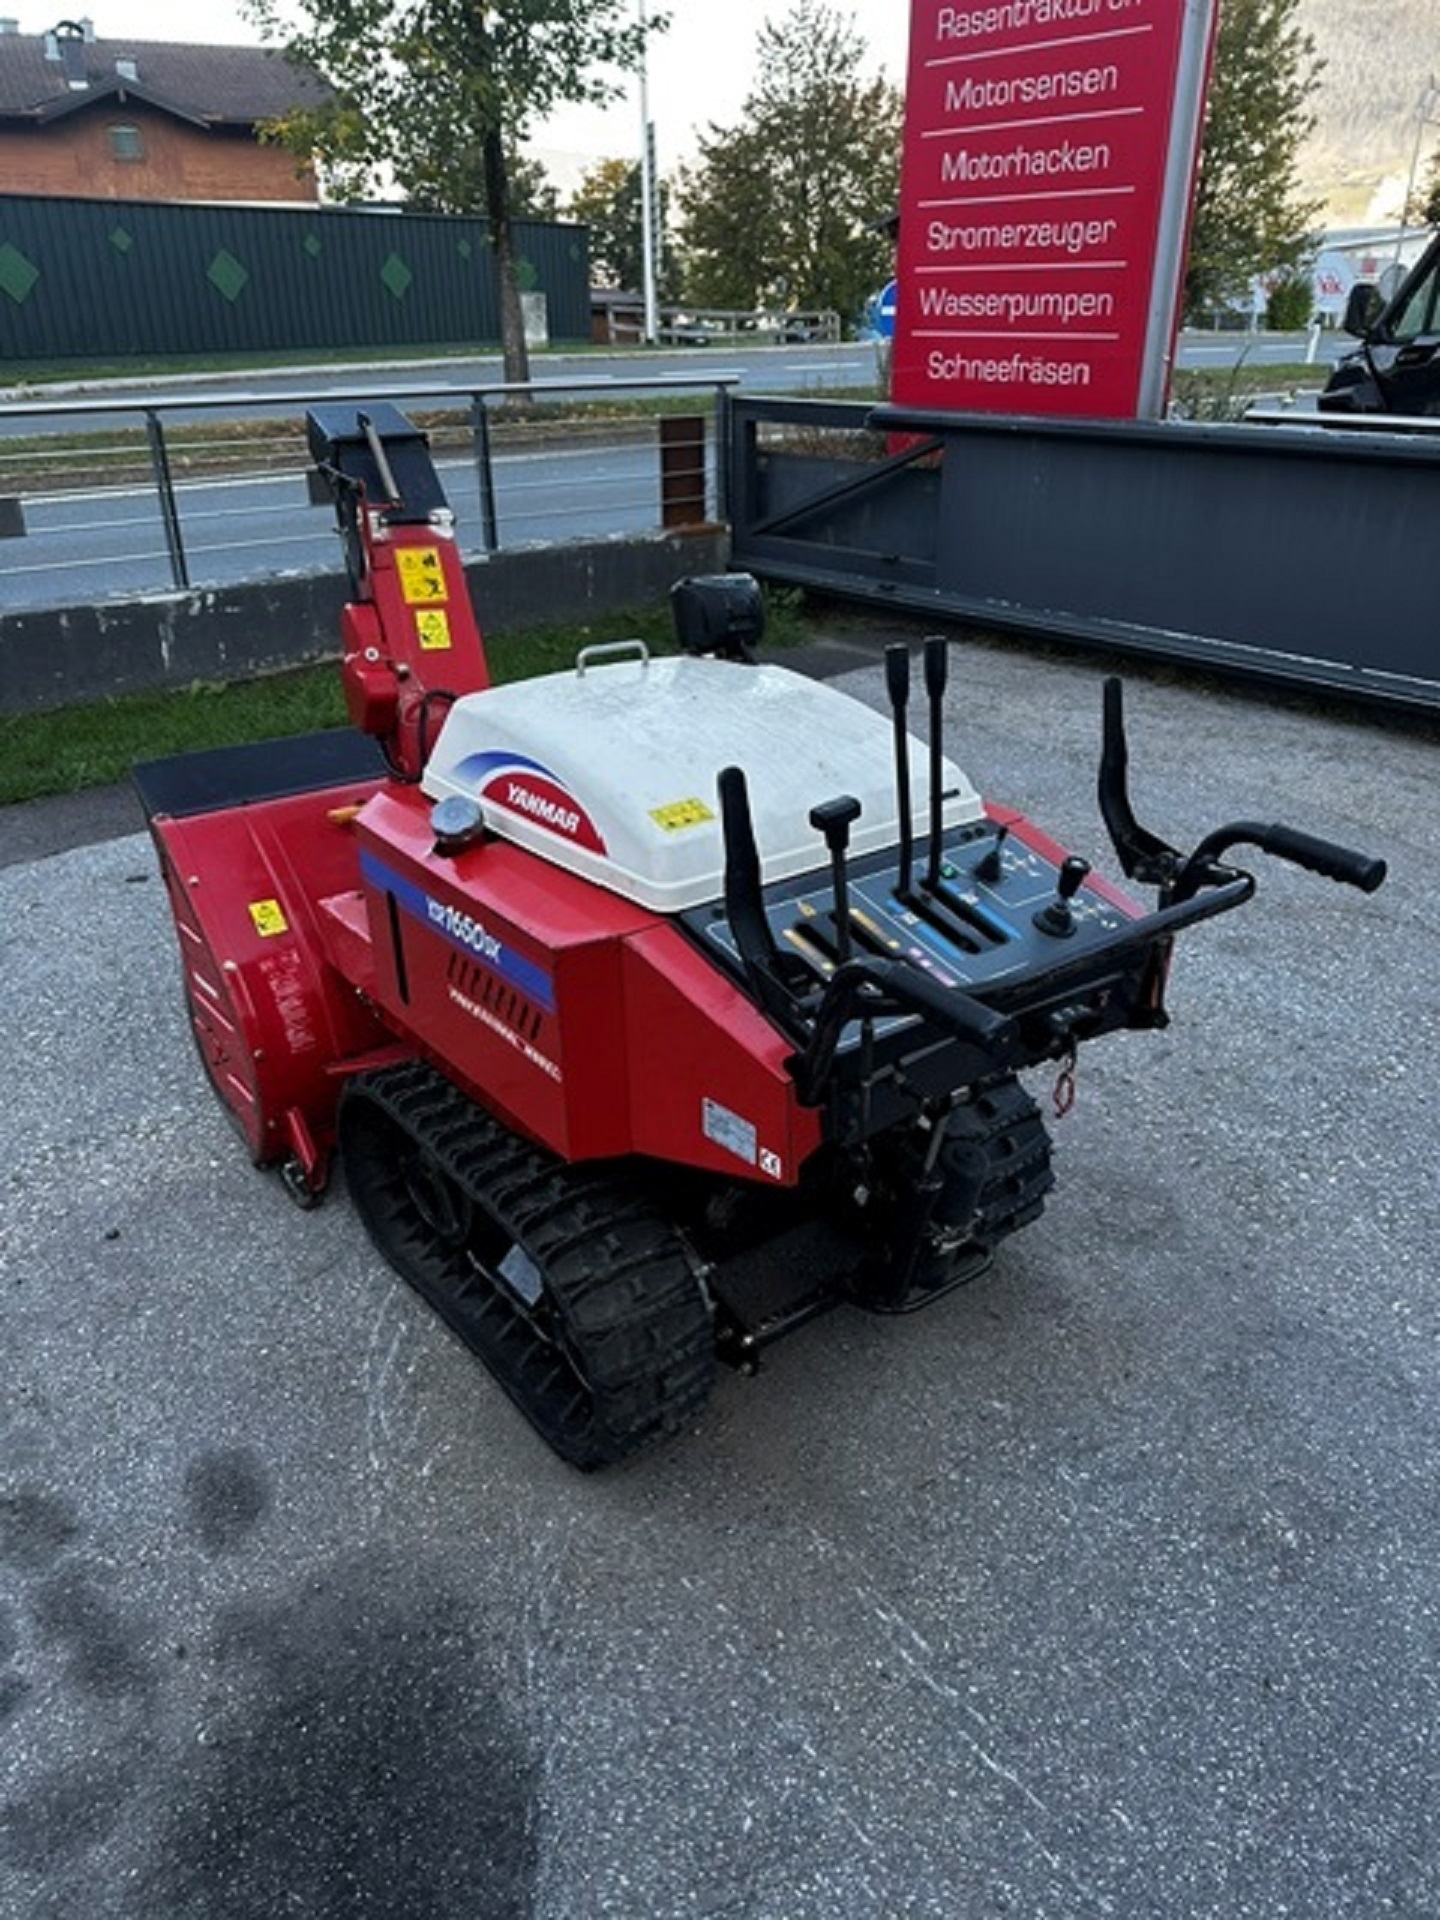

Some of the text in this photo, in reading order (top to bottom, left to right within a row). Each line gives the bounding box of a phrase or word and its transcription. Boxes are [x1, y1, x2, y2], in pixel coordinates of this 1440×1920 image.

[945, 64, 1118, 112] Motorsensen
[941, 141, 1110, 182] Motorhacken
[927, 219, 1117, 253] Stromerzeuger
[919, 288, 1113, 323] Wasserpumpen
[927, 351, 1090, 385] Schneefräsen
[507, 783, 580, 833] YANMAR
